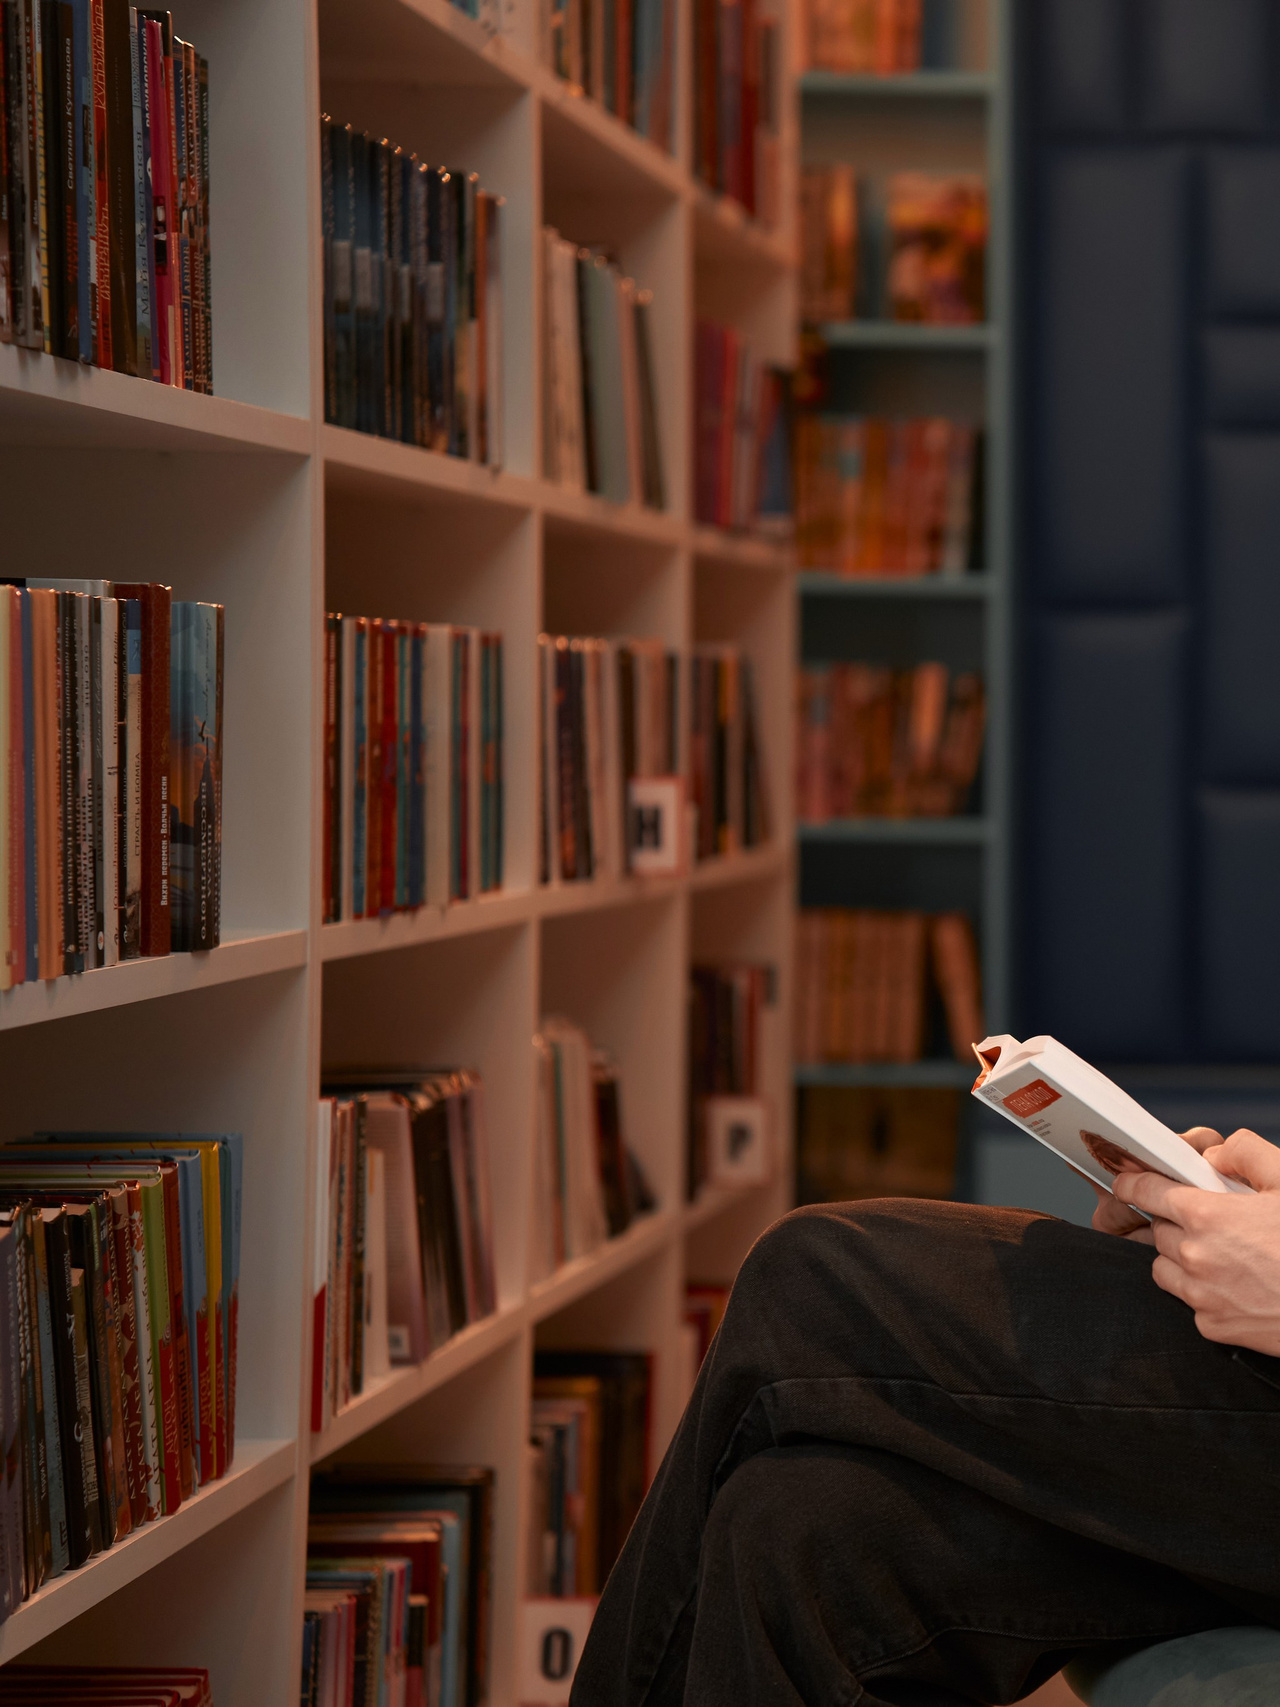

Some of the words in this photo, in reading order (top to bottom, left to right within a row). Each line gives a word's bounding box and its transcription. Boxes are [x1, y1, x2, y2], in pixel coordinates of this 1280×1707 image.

[136, 131, 147, 250] Кучерская
[140, 256, 149, 317] Майя
[160, 803, 168, 835] Волчьи
[160, 878, 168, 906] Вихри
[20, 1239, 31, 1369] КВАРТИРА
[133, 1354, 141, 1414] ЛЕЛЬ
[200, 1371, 208, 1427] АНТОН
[150, 1420, 160, 1487] АГАТА
[164, 1399, 174, 1455] АНТОН
[125, 1433, 136, 1500] АГАТА
[136, 1423, 147, 1494] АГАТА
